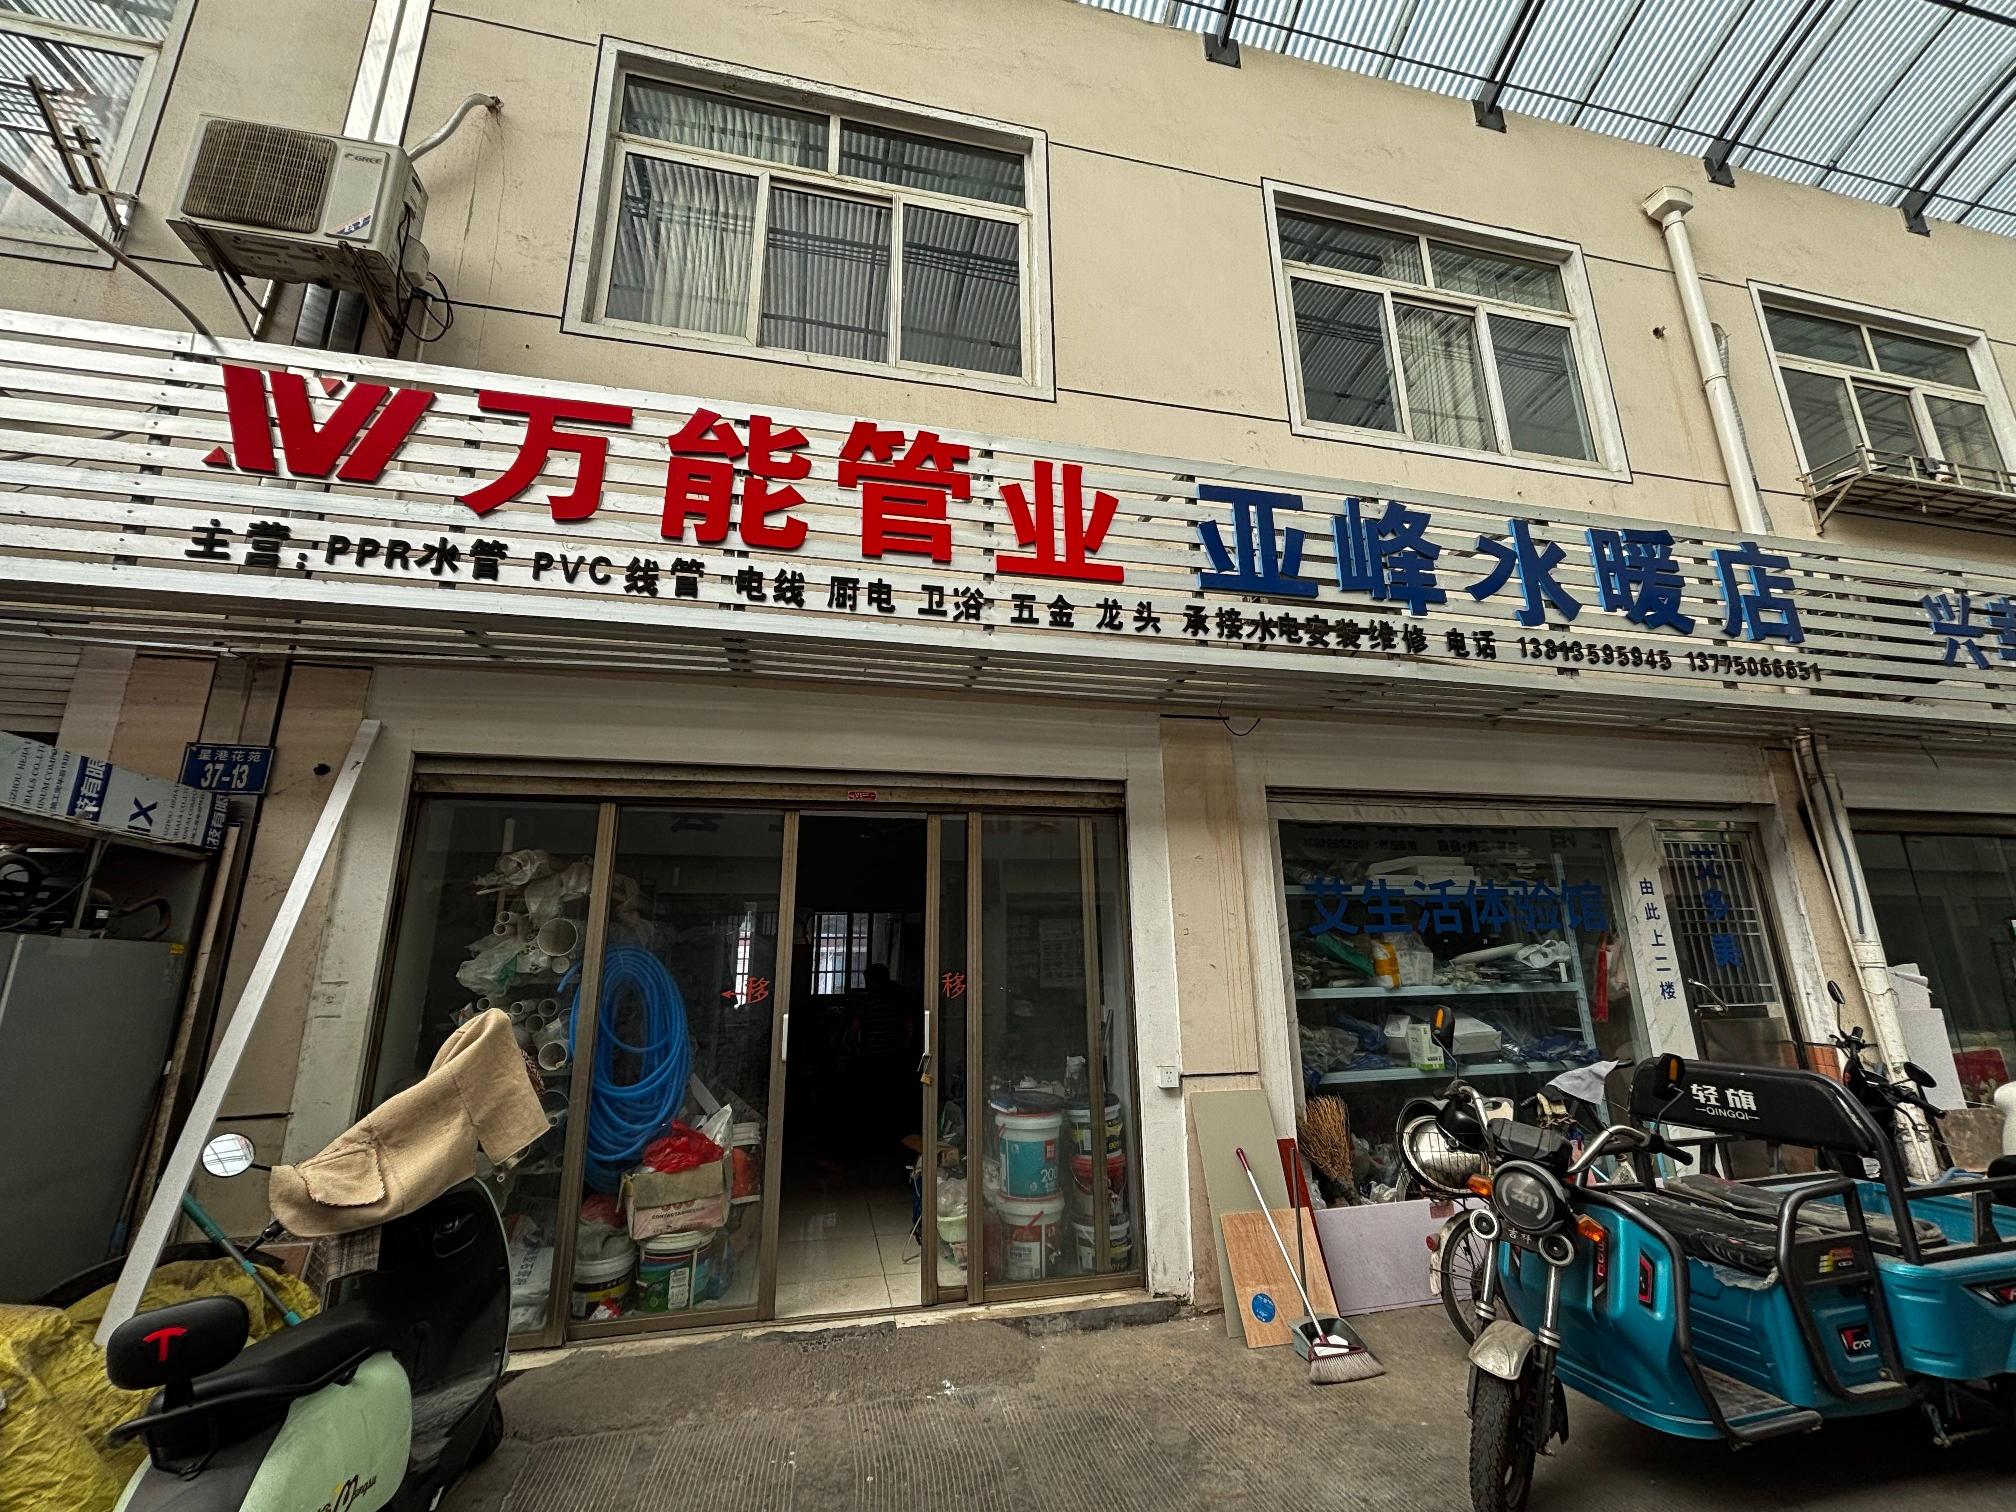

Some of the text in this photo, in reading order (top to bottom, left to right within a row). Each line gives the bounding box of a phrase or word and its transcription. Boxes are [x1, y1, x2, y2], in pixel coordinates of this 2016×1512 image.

[459, 389, 1124, 584] 万能管业
[1196, 483, 1806, 644] 亚峰水暖店
[531, 550, 706, 598] PVC线管
[736, 565, 805, 608] 电线
[827, 576, 896, 613] 厨电
[918, 584, 986, 621] 卫浴
[1010, 594, 1075, 628] 五金
[1096, 597, 1162, 634] 龙头
[1183, 605, 1429, 654] 承接水电安装维修
[1446, 627, 1498, 660] 电话
[1516, 636, 1672, 671] 13813595945
[1686, 651, 1823, 682] 13775066651
[201, 763, 250, 789] 37-13
[1305, 876, 1609, 937] 艾生活体验馆
[1639, 878, 1677, 1000] 由此上二楼
[747, 976, 770, 1004] 移
[942, 972, 966, 999] 移
[1706, 1106, 1749, 1120] QINGQI
